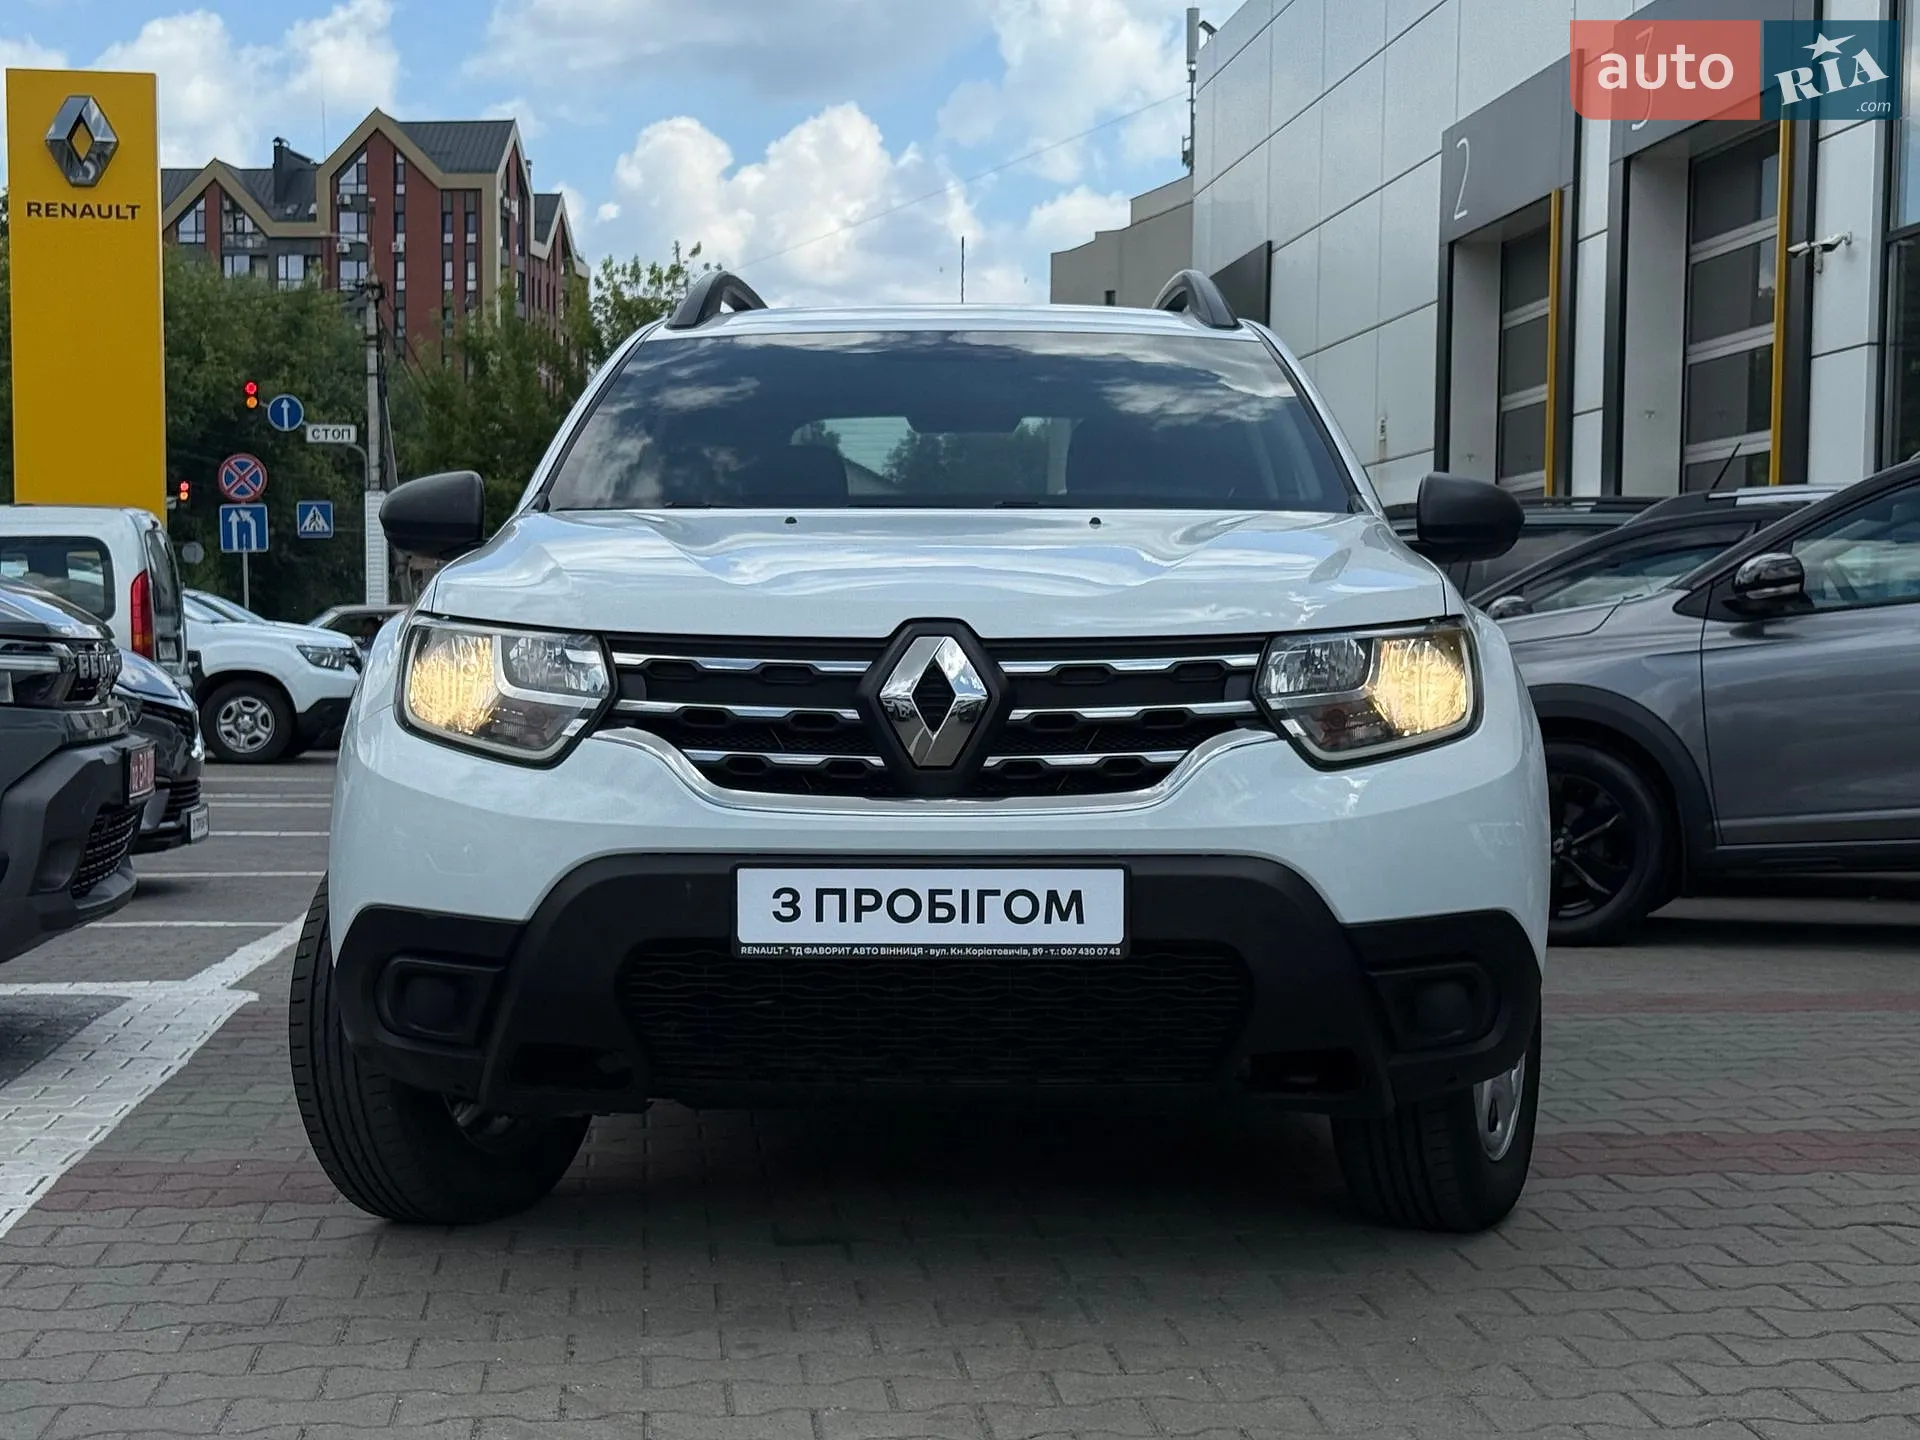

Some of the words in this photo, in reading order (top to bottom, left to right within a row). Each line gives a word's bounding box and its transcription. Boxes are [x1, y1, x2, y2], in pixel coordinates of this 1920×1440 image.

[1453, 137, 1471, 221] 2
[26, 201, 141, 220] RENAULT
[311, 428, 351, 441] СТОП
[771, 887, 802, 923] З
[815, 887, 1085, 925] ПРОБІГОМ
[740, 946, 783, 955] RENAULT
[791, 946, 803, 956] ТД
[803, 946, 850, 955] ФАВОРИТ
[852, 946, 878, 955] АВТО
[880, 945, 924, 957] ВІННИЦЯ
[930, 947, 949, 957] вул.
[1032, 947, 1043, 956] 89
[1061, 947, 1077, 956] 067
[1078, 947, 1095, 956] 430
[1097, 947, 1108, 956] 07
[1109, 947, 1121, 956] 43
